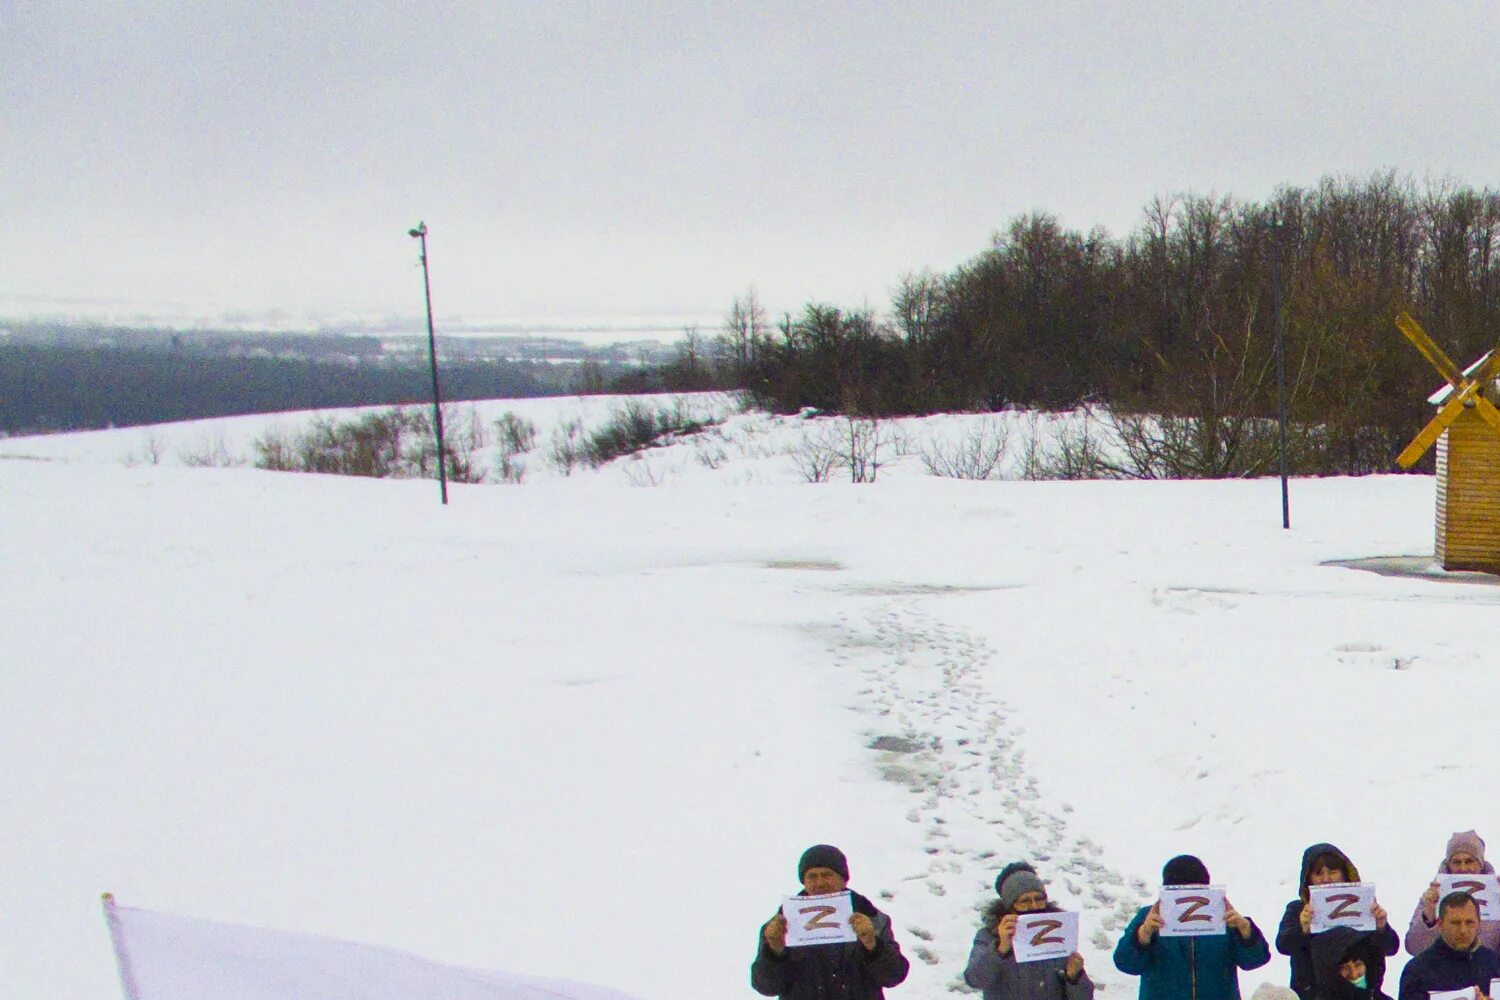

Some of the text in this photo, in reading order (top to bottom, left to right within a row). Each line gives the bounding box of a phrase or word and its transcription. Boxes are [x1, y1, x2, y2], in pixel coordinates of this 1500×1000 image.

[799, 905, 841, 931] Z
[1175, 895, 1213, 923] Z
[1325, 894, 1362, 920] Z
[1027, 920, 1066, 947] Z
